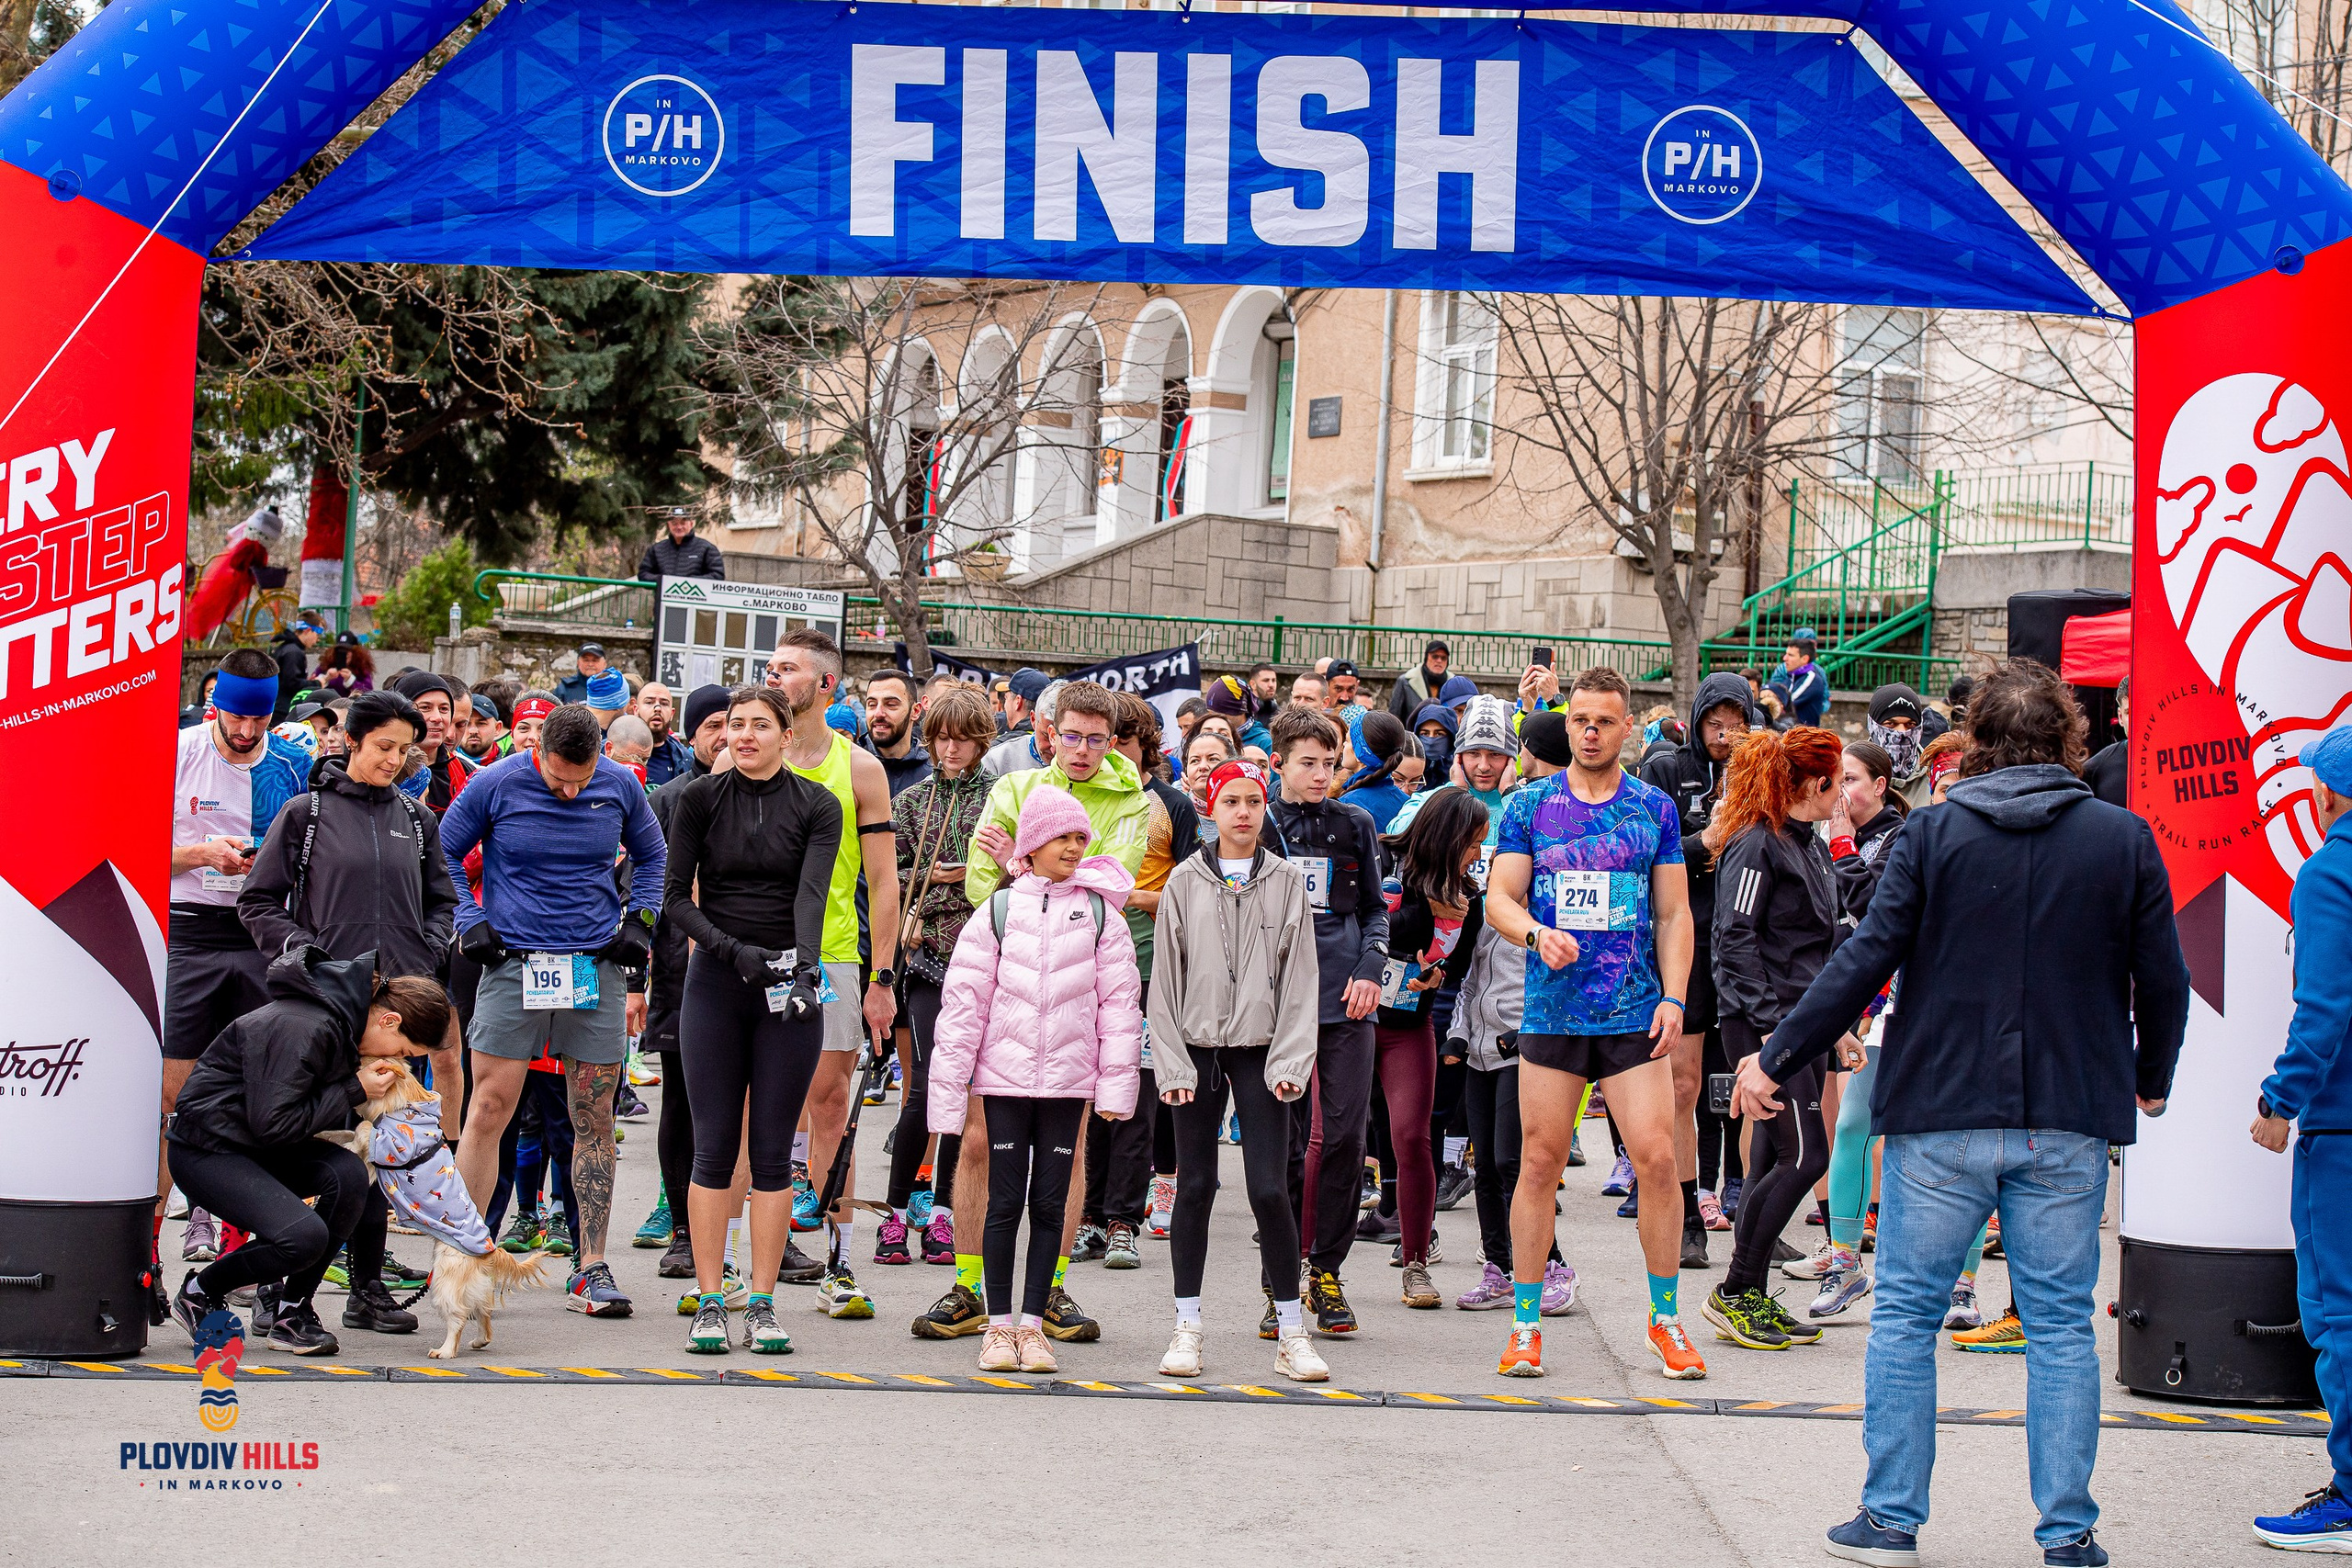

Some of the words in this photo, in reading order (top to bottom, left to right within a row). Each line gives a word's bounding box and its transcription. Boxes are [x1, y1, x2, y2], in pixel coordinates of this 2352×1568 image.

[656, 99, 672, 108] IN
[626, 113, 702, 152] P/H
[1695, 130, 1710, 138] IN
[626, 155, 701, 166] MARKOVO
[850, 43, 1521, 253] FINISH
[1665, 141, 1740, 180] P/H
[1664, 184, 1739, 195] MARKOVO
[0, 491, 170, 619] STEP
[712, 583, 804, 600] ИНФОРМАЦИОННО
[807, 592, 839, 603] ТАБЛО
[2141, 713, 2156, 789] PLOVDIV
[2158, 683, 2199, 712] HILLS
[2209, 683, 2226, 696] IN
[2235, 693, 2287, 767] MARKOVO
[2156, 736, 2251, 774] PLOVDIV
[2174, 770, 2239, 804] HILLS
[2153, 815, 2188, 849] TRAIL
[2199, 836, 2233, 851] RUN
[2240, 799, 2277, 838] RACE
[301, 825, 316, 865] UNDER
[1566, 888, 1599, 908] 274
[533, 970, 561, 987] 196
[994, 1142, 1014, 1150] NIKE
[1054, 1146, 1072, 1155] PRO
